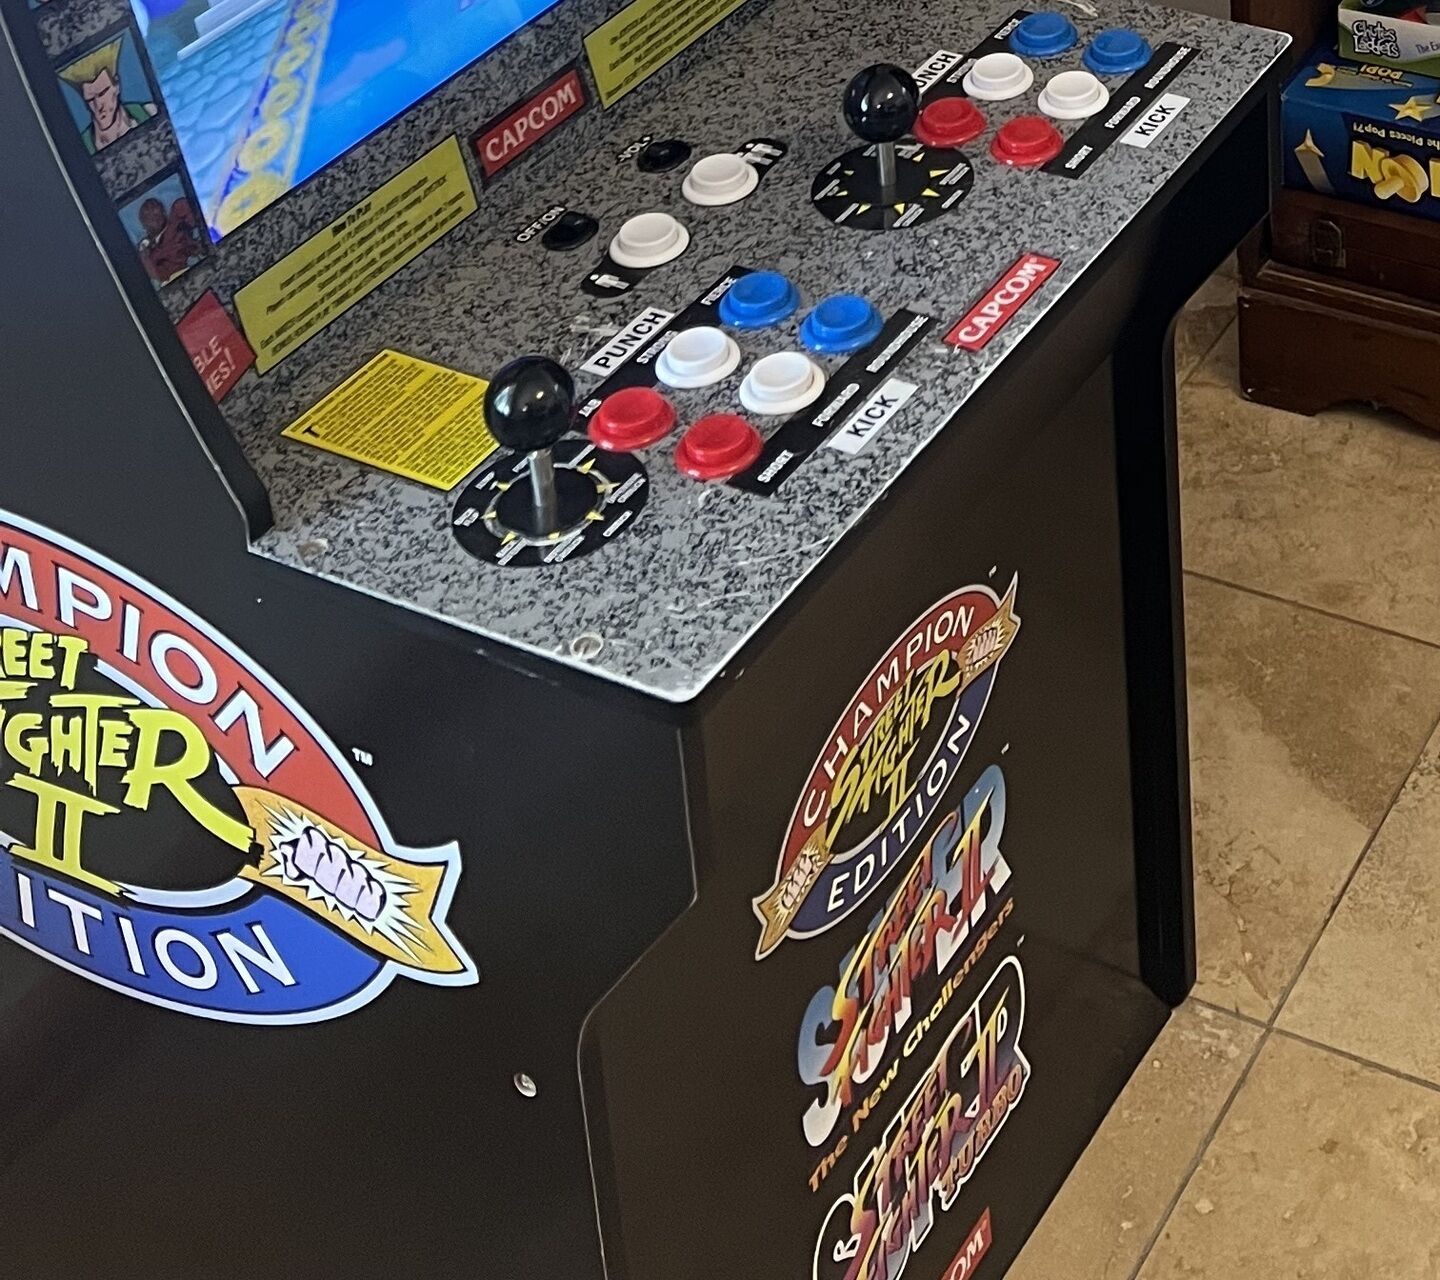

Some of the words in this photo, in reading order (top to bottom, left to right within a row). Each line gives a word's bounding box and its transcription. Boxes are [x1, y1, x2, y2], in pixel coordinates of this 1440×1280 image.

[1353, 19, 1397, 40] Chutes
[1353, 34, 1399, 58] Ladders
[1416, 44, 1429, 54] The
[915, 53, 956, 88] UNCH
[1359, 64, 1403, 80] POP!
[486, 84, 577, 162] CAPCOM
[1134, 104, 1175, 137] KICK
[1352, 122, 1385, 138] Pop?!
[1389, 130, 1423, 148] Pieces
[517, 206, 565, 242] OFF/ON
[958, 260, 1047, 344] CAPCOM
[593, 310, 667, 369] PUNCH
[846, 394, 899, 438] KICK
[803, 605, 975, 828] CHAMPION
[848, 648, 963, 824] FIGHTER
[826, 667, 915, 848] STREET
[876, 739, 920, 818] II
[5, 772, 122, 896] II
[827, 714, 971, 913] EDITION
[820, 812, 958, 1077] STREET
[808, 1134, 848, 1192] The
[852, 1059, 899, 1133] New
[903, 897, 1016, 1058] Challengers
[939, 1064, 1023, 1198] TURBO
